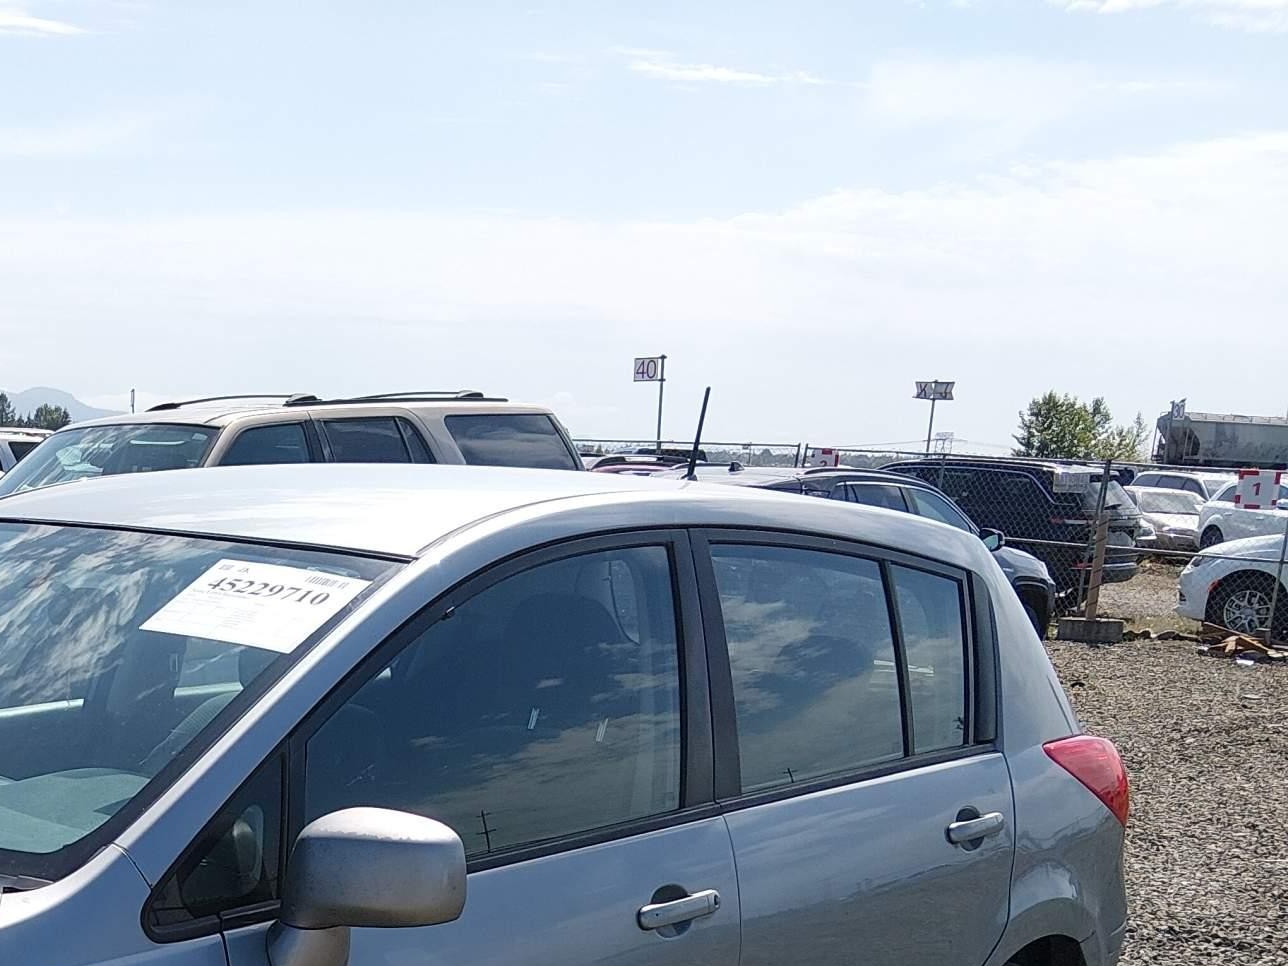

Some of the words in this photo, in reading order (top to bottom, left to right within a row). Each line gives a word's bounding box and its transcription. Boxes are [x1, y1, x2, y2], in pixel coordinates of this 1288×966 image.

[636, 360, 656, 379] 40
[917, 383, 928, 397] K
[1253, 482, 1260, 496] 1
[207, 576, 330, 606] 45229710
